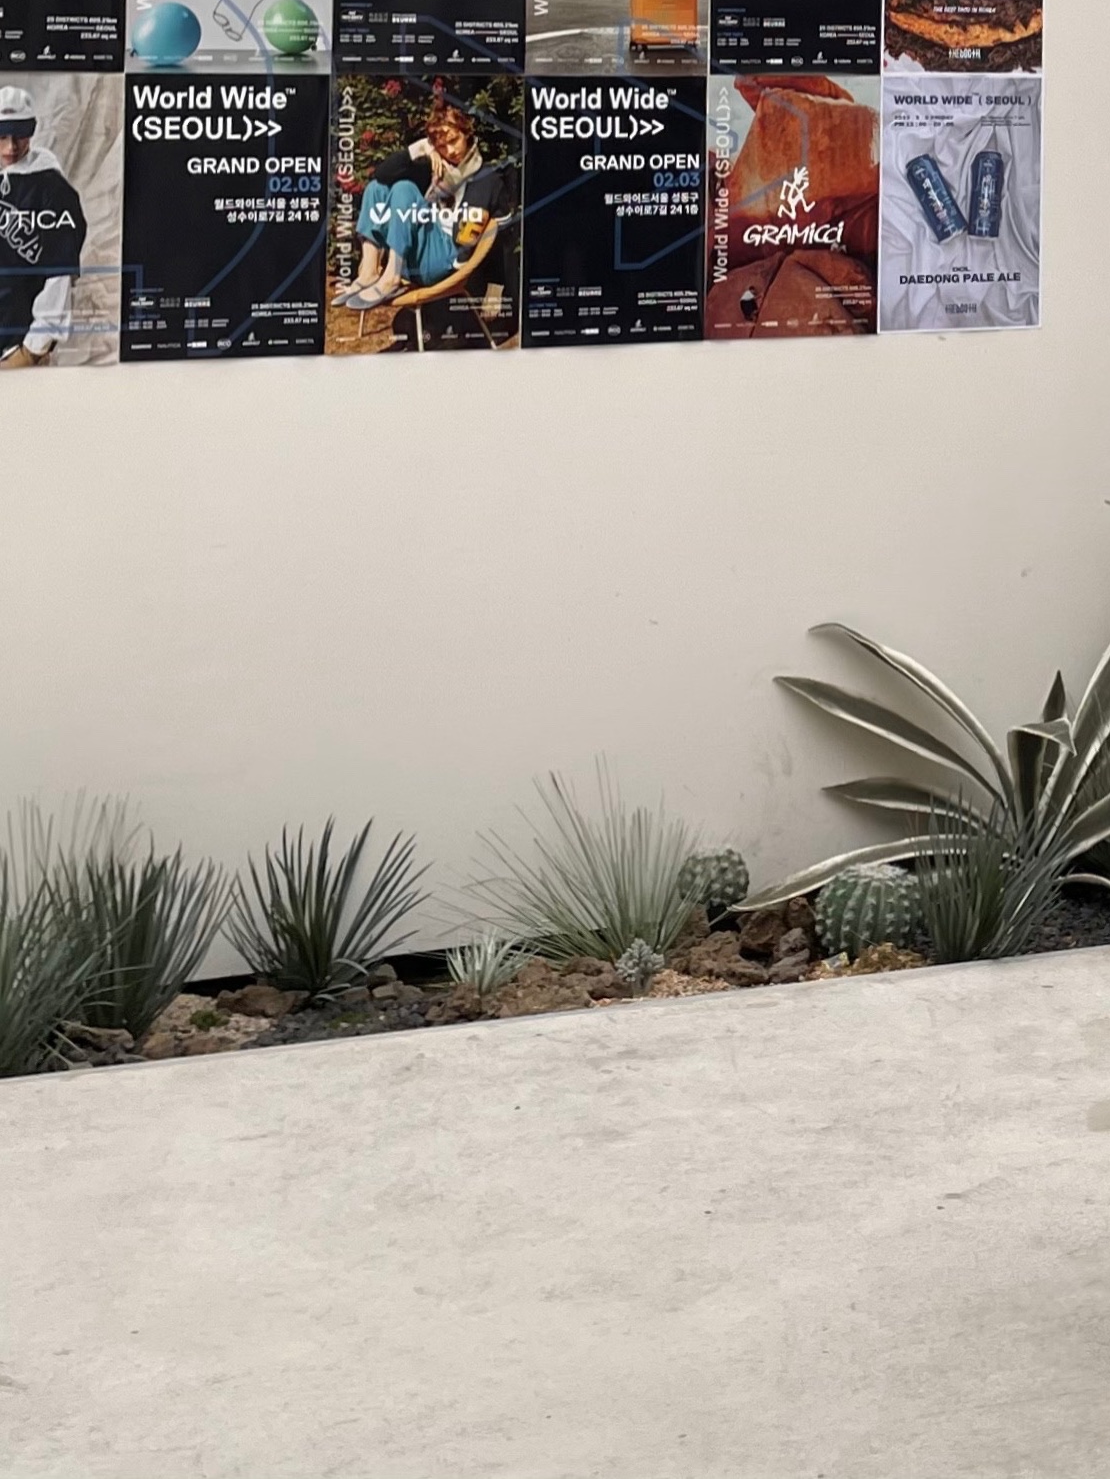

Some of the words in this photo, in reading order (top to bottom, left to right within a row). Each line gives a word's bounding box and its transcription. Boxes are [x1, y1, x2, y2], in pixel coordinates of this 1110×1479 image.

[133, 85, 212, 110] World
[531, 87, 602, 110] World
[894, 95, 938, 106] WORLD
[186, 157, 260, 174] GRAND
[264, 156, 321, 174] OPEN
[579, 154, 645, 171] GRAND
[649, 153, 700, 170] OPEN
[269, 176, 321, 193] 02.03
[653, 172, 700, 188] 02.03
[287, 211, 302, 222] 24
[396, 202, 483, 224] victoria
[670, 204, 683, 215] 24
[713, 235, 729, 283] World
[335, 243, 352, 294] World
[899, 273, 960, 285] DAEDONG
[963, 272, 995, 284] PALE
[997, 271, 1021, 282] ALE
